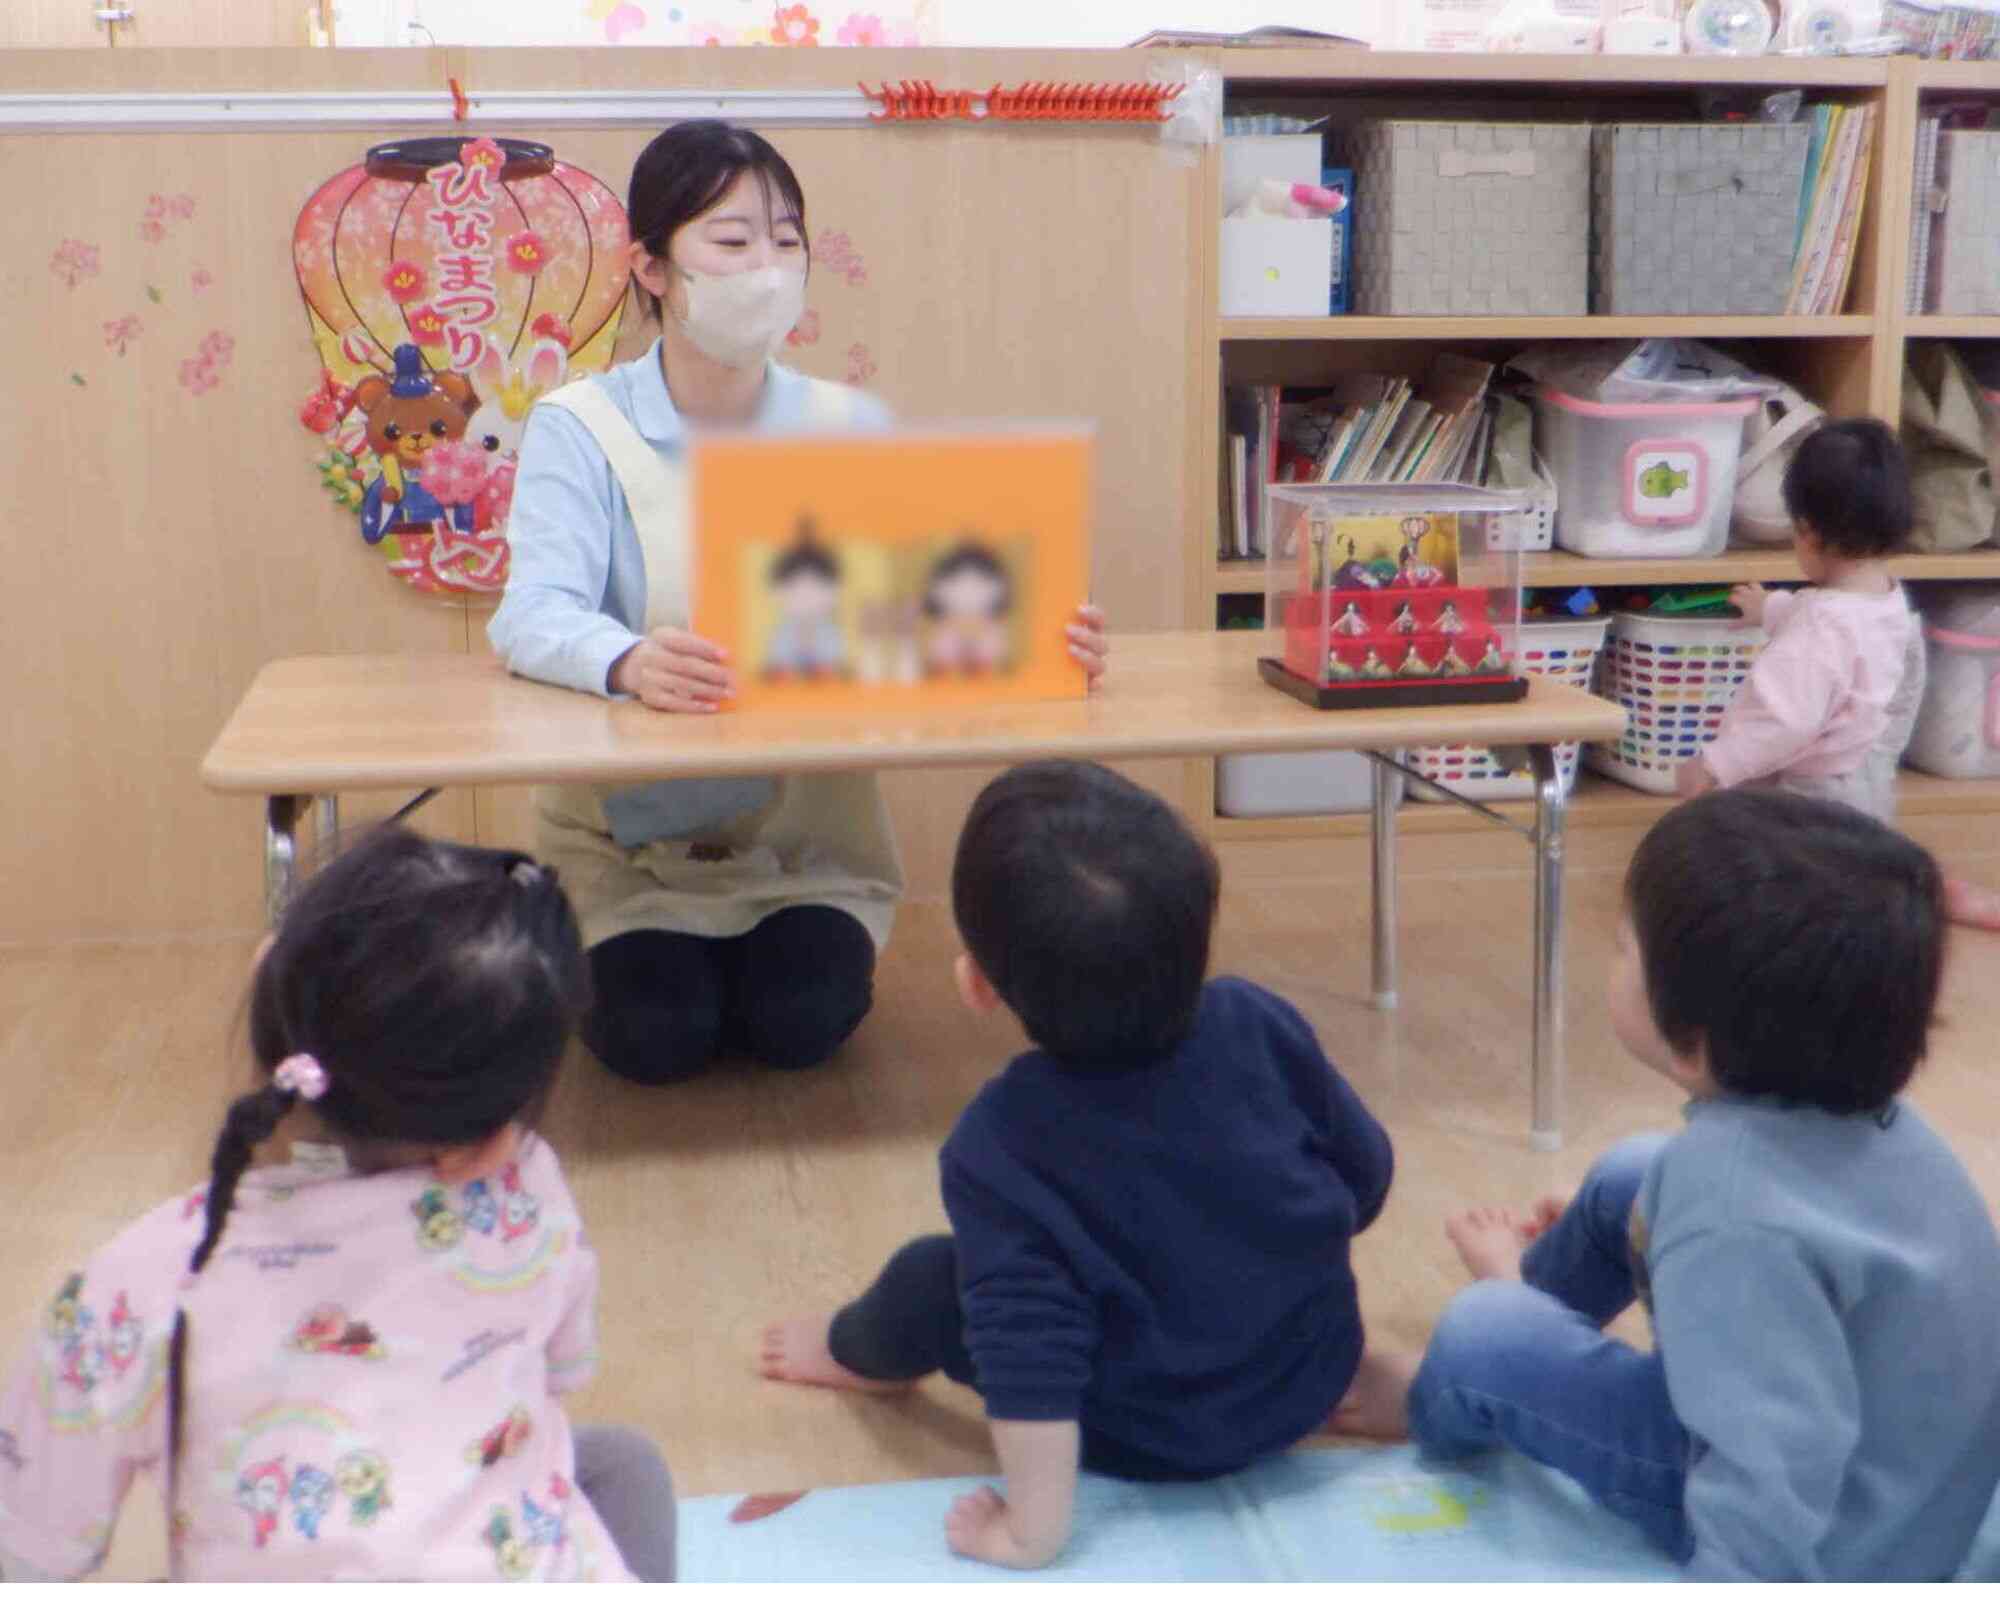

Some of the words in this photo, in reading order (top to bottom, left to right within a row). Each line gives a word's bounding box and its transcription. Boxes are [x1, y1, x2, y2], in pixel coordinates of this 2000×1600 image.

[428, 164, 498, 370] ひなまつり
